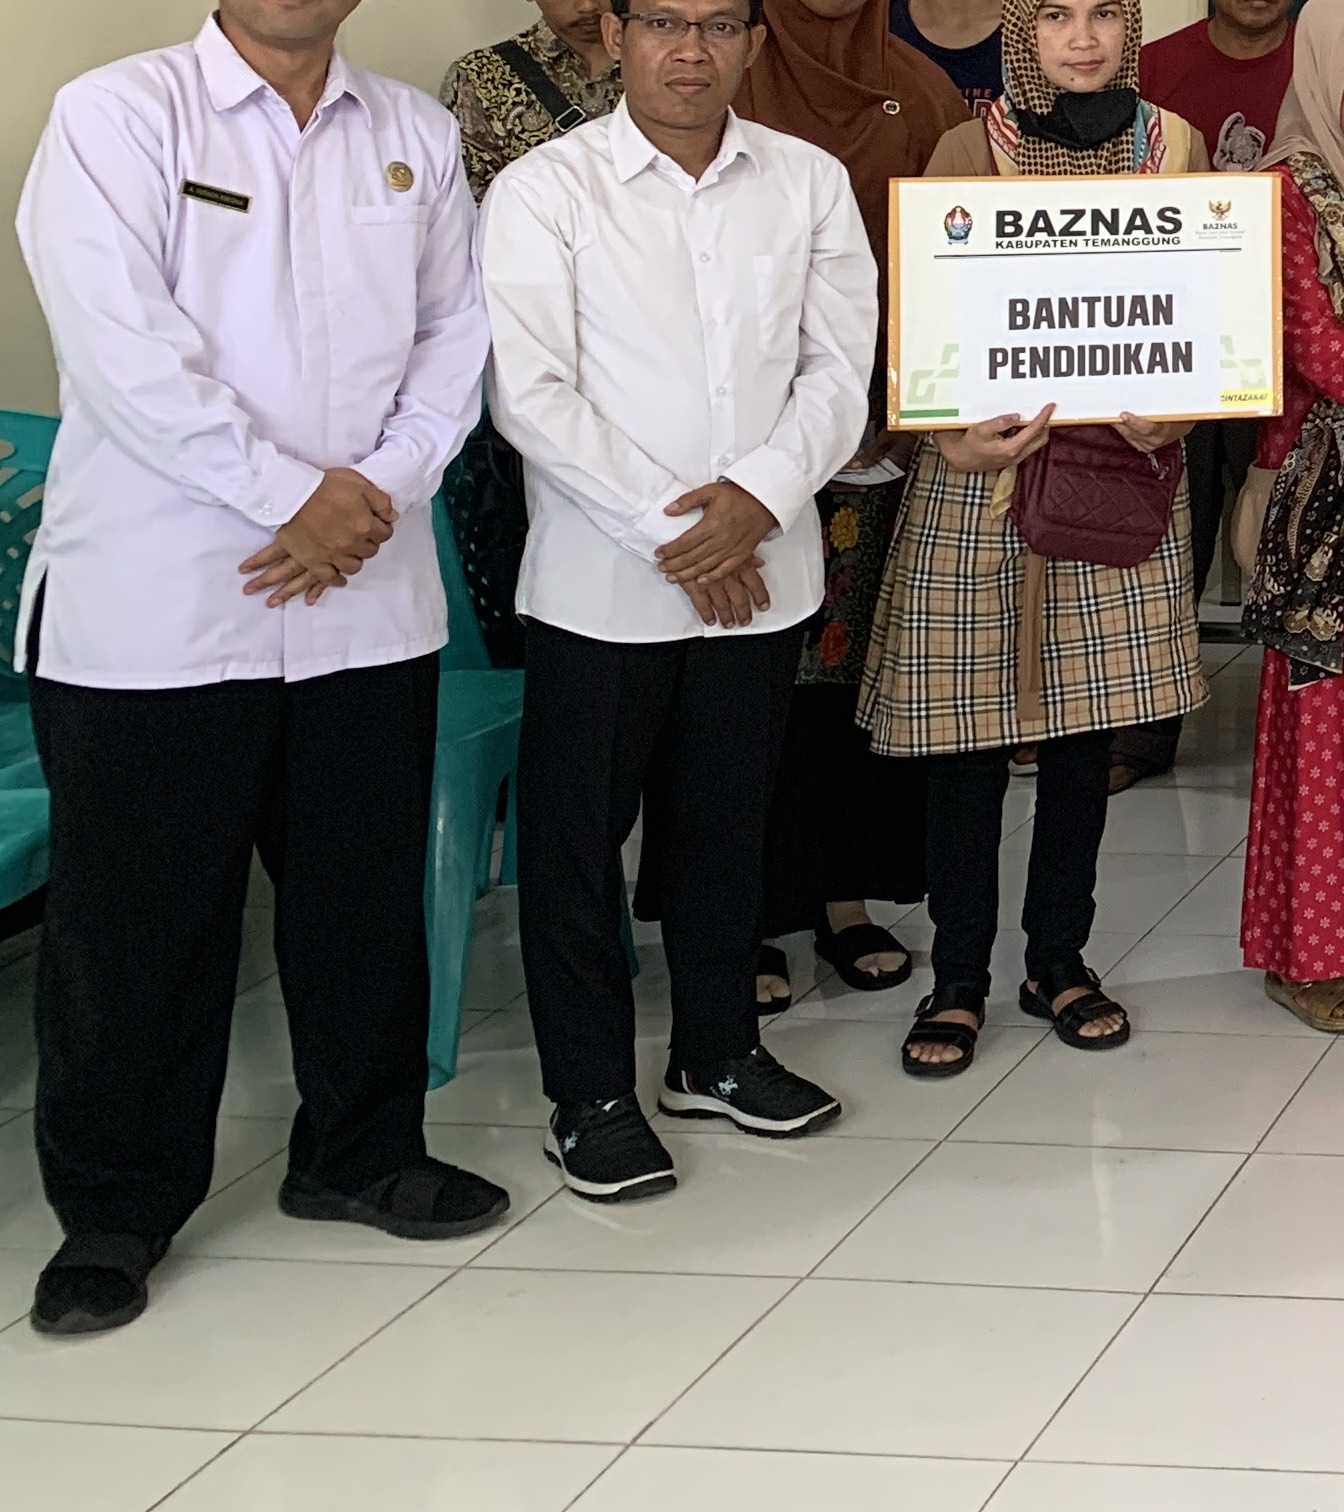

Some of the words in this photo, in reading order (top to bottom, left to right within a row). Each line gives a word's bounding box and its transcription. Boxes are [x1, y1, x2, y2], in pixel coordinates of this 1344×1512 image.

[996, 206, 1183, 238] BAZNAS
[1202, 222, 1238, 230] BAZNAS
[995, 239, 1079, 249] KABUPATEN
[1083, 236, 1181, 248] TEMANGGUNG
[1008, 294, 1174, 331] BANTUAN
[988, 341, 1193, 381] PENDIDIKAN
